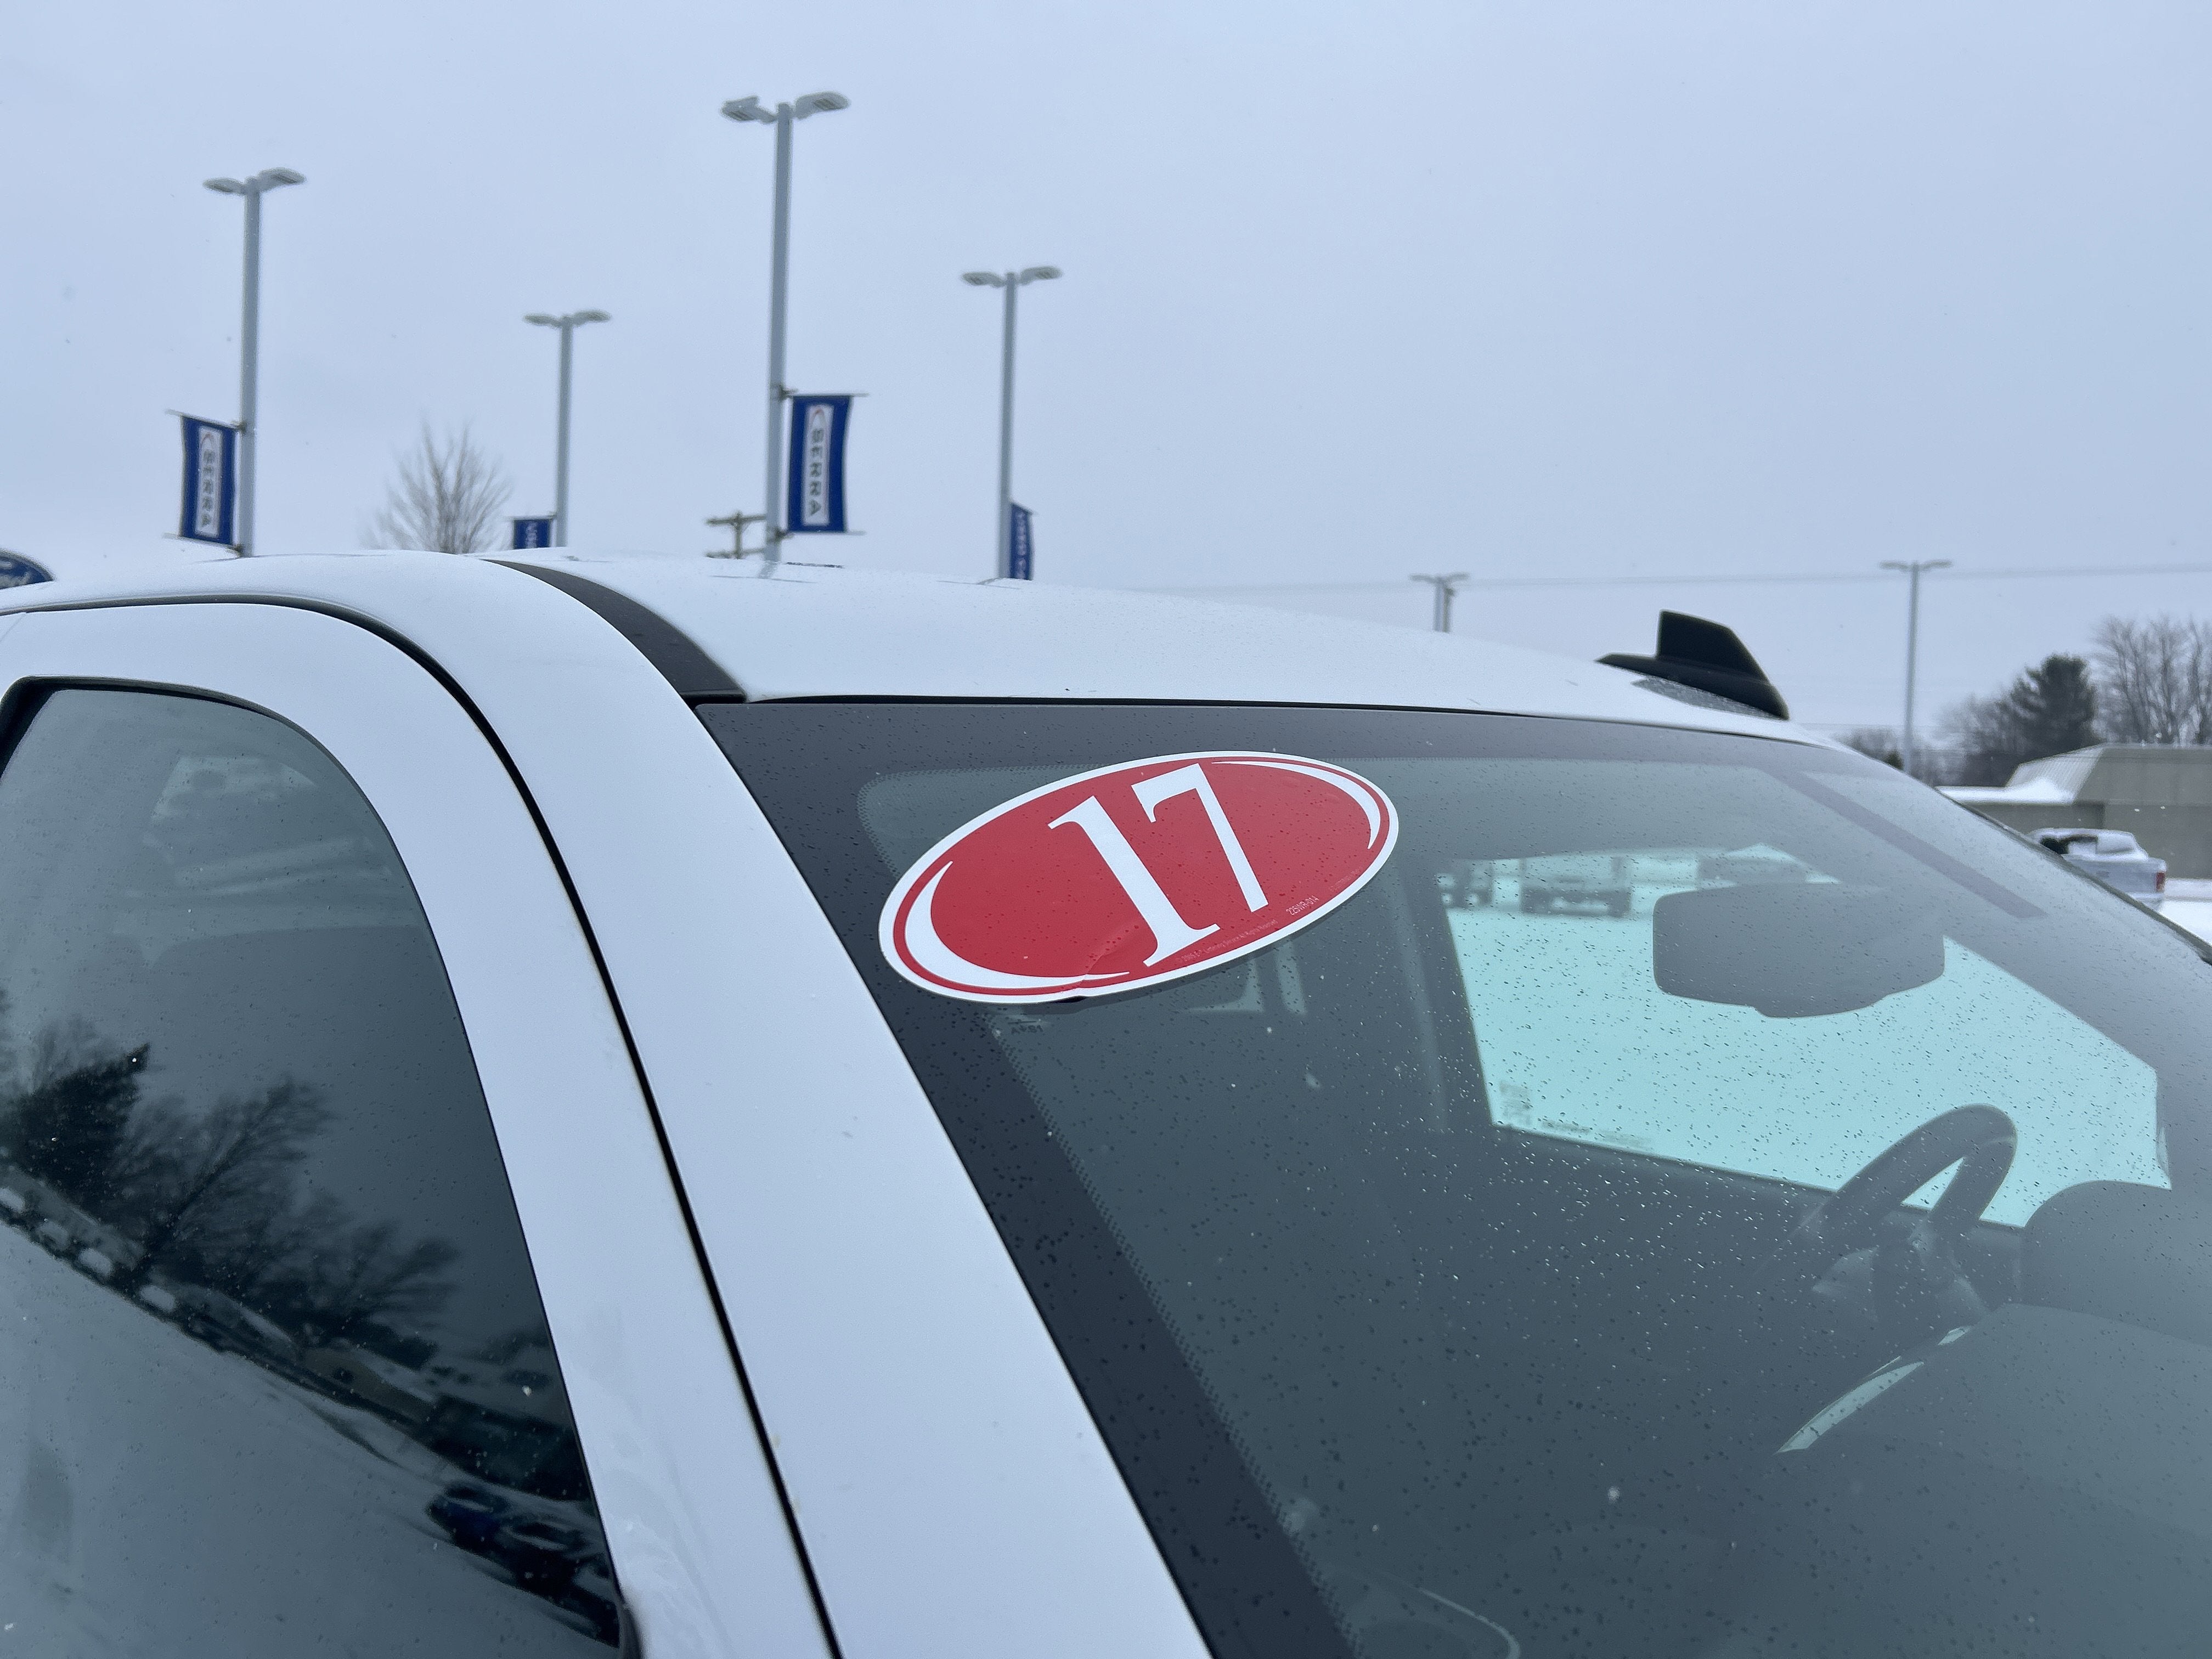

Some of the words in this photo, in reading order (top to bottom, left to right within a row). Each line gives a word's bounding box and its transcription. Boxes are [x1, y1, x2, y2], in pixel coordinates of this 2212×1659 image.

[201, 449, 215, 528] SERRA
[808, 427, 824, 516] SERRA
[1047, 763, 1269, 967] 17
